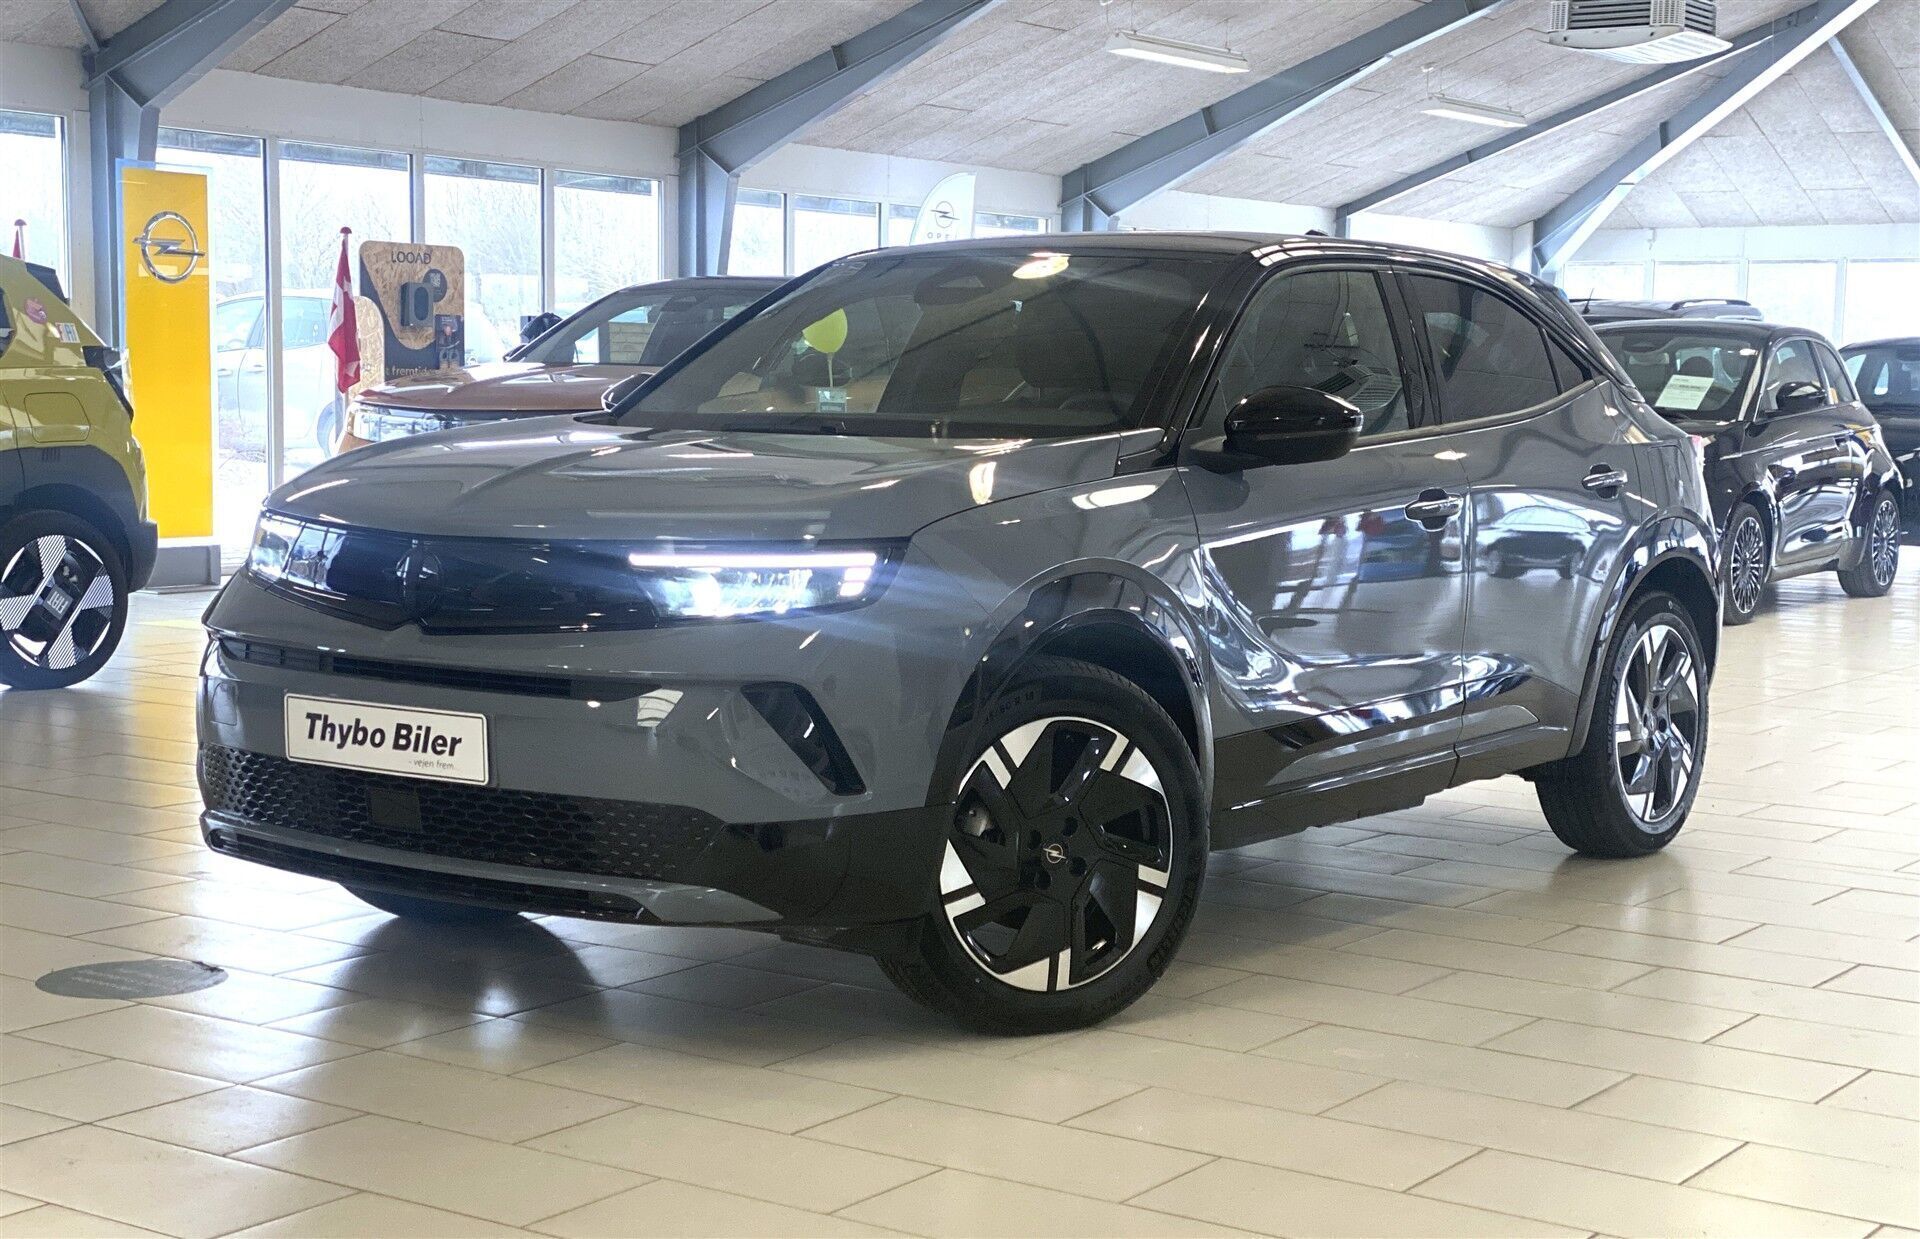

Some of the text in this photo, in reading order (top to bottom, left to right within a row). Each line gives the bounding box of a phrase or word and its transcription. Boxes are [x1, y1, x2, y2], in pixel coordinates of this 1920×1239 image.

[46, 590, 69, 614] FIAT
[305, 712, 462, 756] Thybo Biler
[413, 759, 435, 769] vejen
